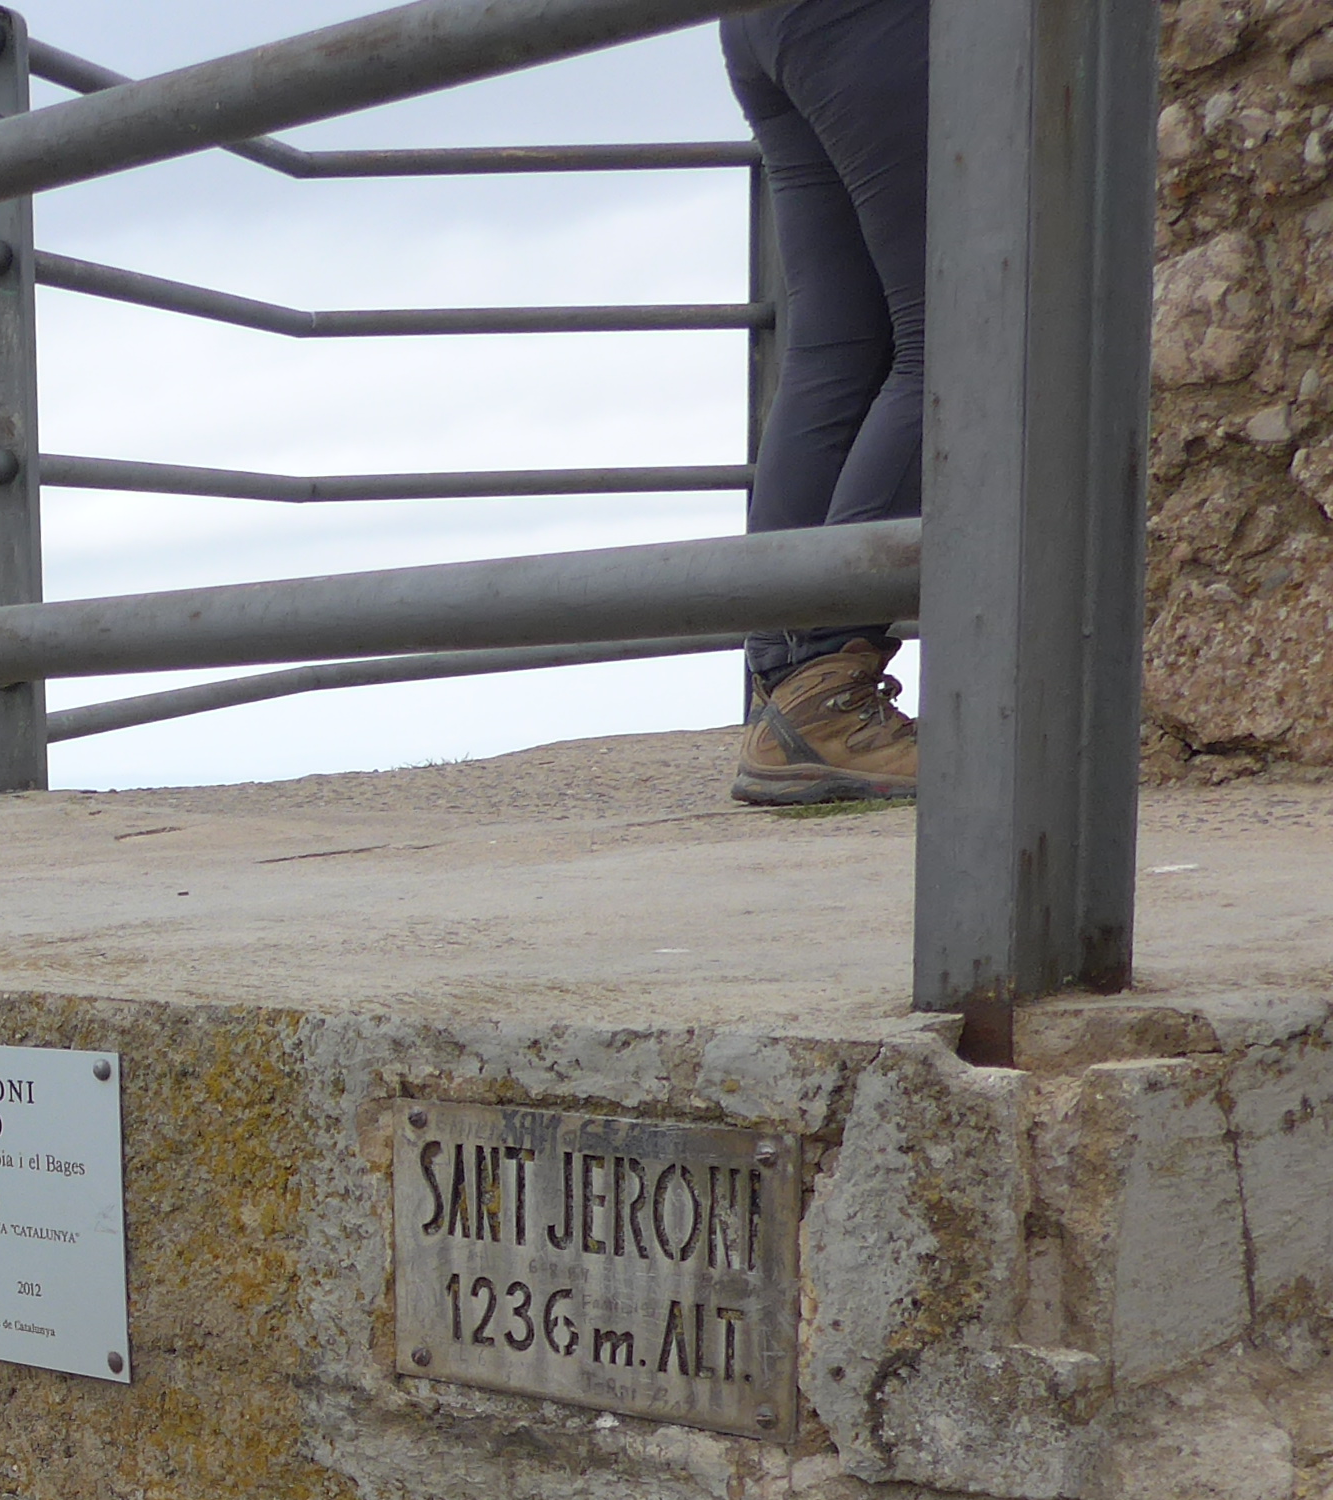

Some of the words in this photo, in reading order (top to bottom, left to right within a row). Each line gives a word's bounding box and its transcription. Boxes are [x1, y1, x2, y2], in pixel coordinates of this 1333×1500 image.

[18, 1152, 24, 1169] i
[28, 1154, 40, 1170] el
[46, 1155, 85, 1176] Bages
[420, 1141, 535, 1246] SANT
[547, 1152, 761, 1272] JERONI
[10, 1224, 80, 1244] "CATALUNYA"
[17, 1281, 42, 1297] 2012
[3, 1319, 13, 1329] de
[14, 1320, 56, 1337] Catalunya
[445, 1273, 580, 1356] 1236
[658, 1300, 753, 1384] ALT.
